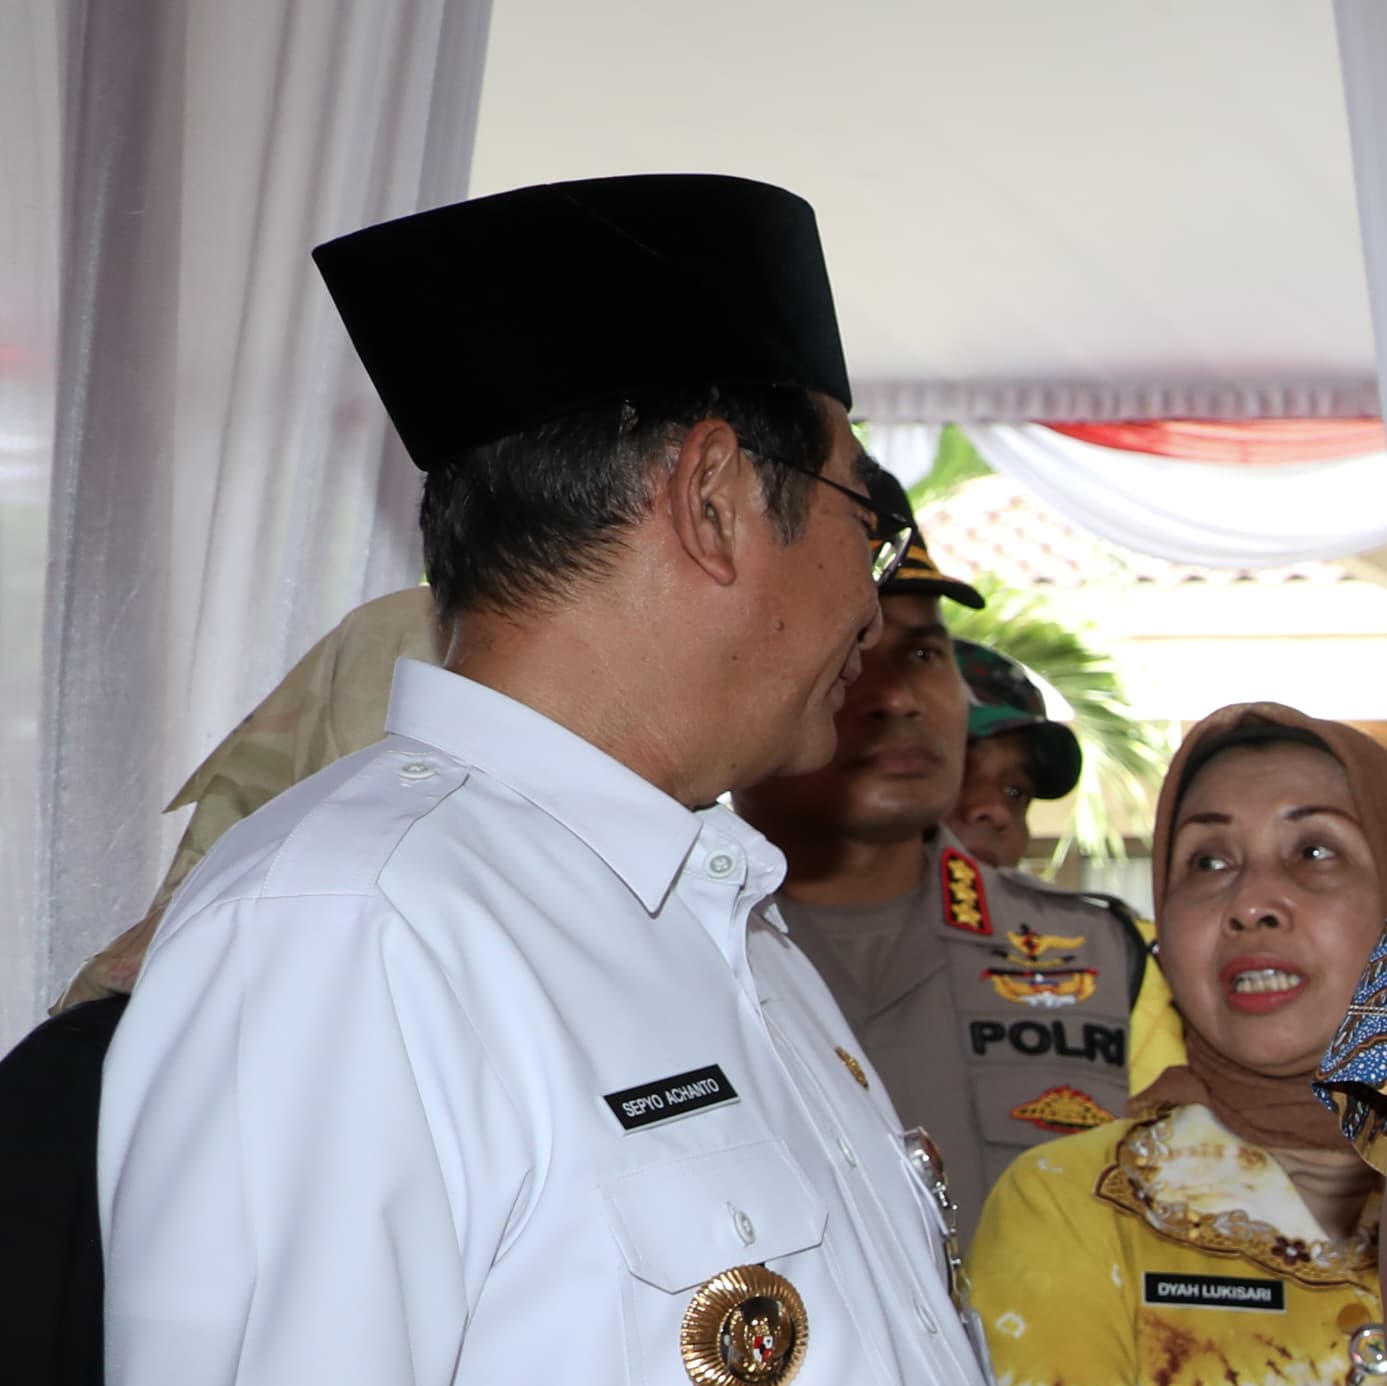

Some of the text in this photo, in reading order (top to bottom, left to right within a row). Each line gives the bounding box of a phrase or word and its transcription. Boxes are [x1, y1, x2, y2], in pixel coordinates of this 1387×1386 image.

[969, 1021, 1125, 1067] POLRI
[622, 1078, 720, 1117] SEPYO ACHANTO
[1158, 1282, 1271, 1302] DYAH LUKISARI
